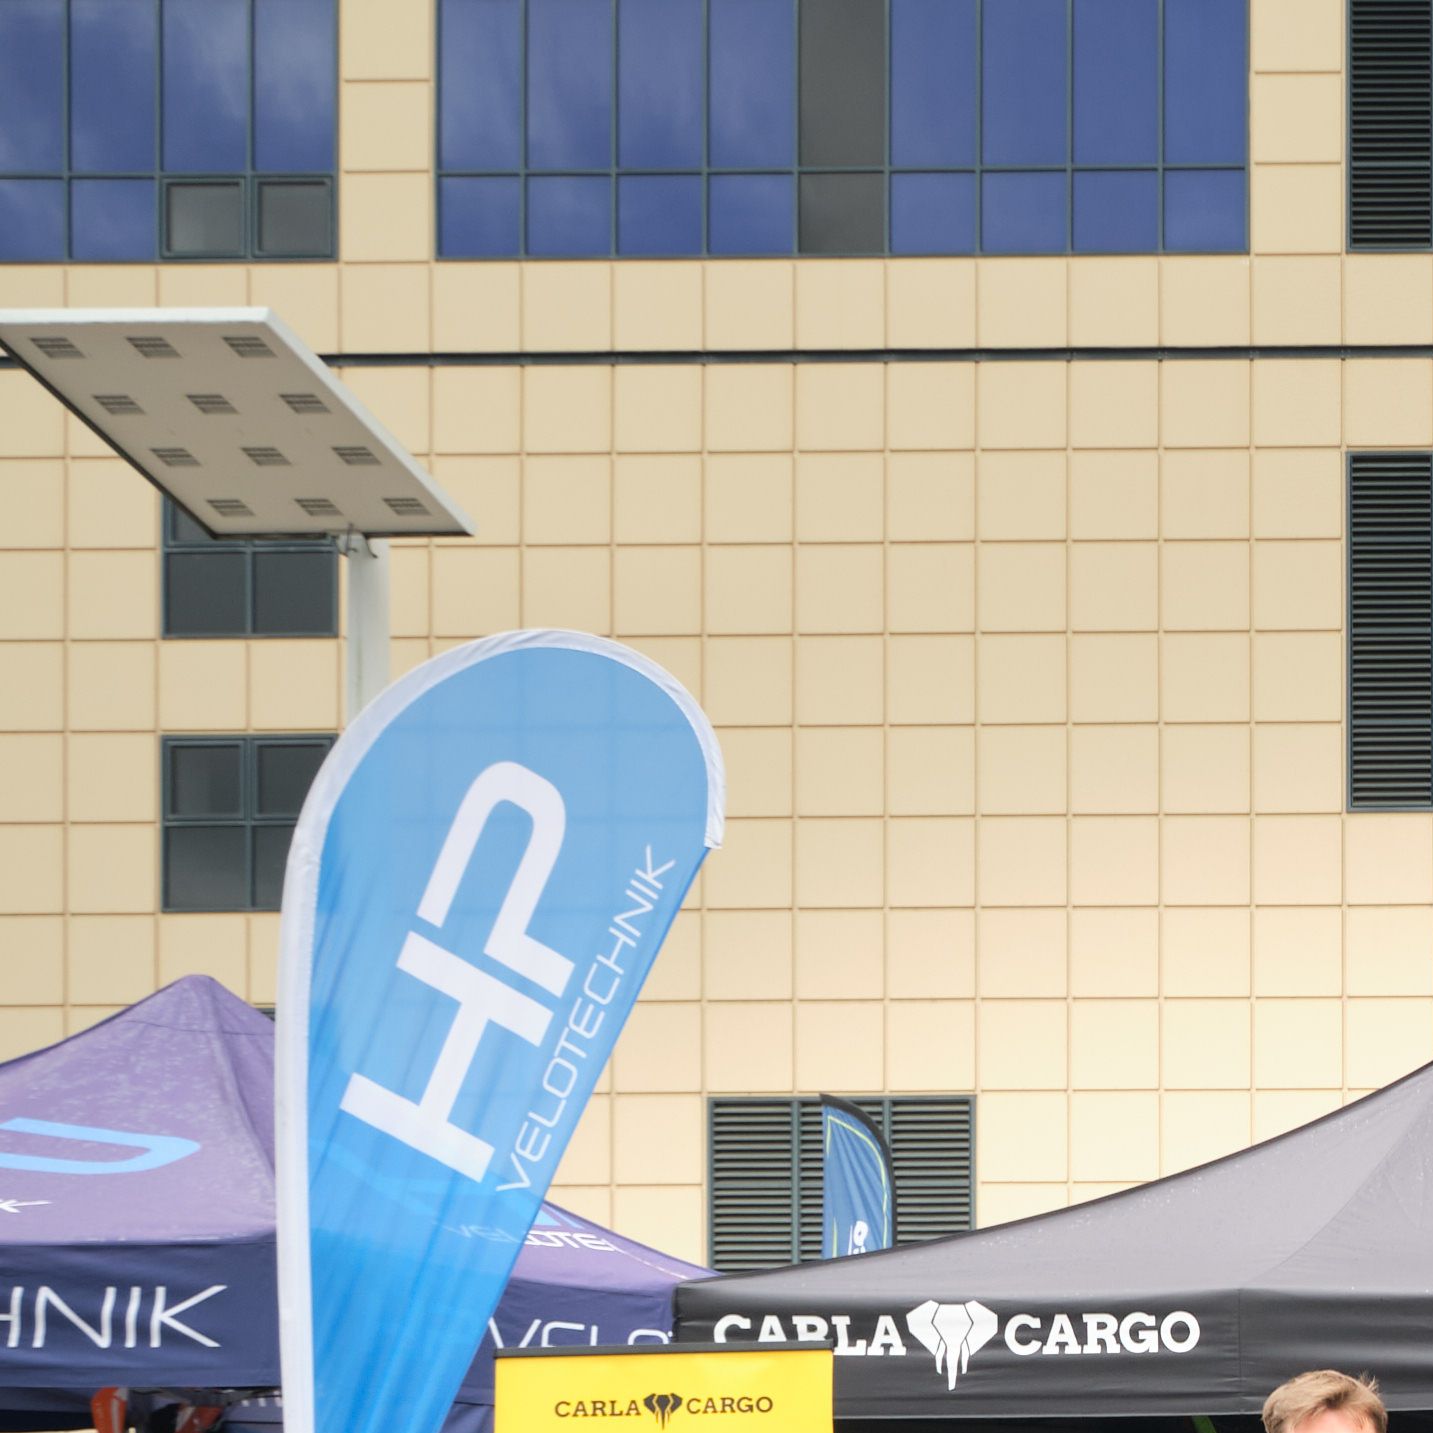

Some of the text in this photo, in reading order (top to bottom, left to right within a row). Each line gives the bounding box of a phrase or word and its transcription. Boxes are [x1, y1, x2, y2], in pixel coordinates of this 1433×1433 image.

[340, 761, 575, 1183] HP
[496, 845, 676, 1192] VELOTECHNIK
[554, 1396, 773, 1418] CARLA CARGO
[714, 1310, 1201, 1356] CARLA CARGO
